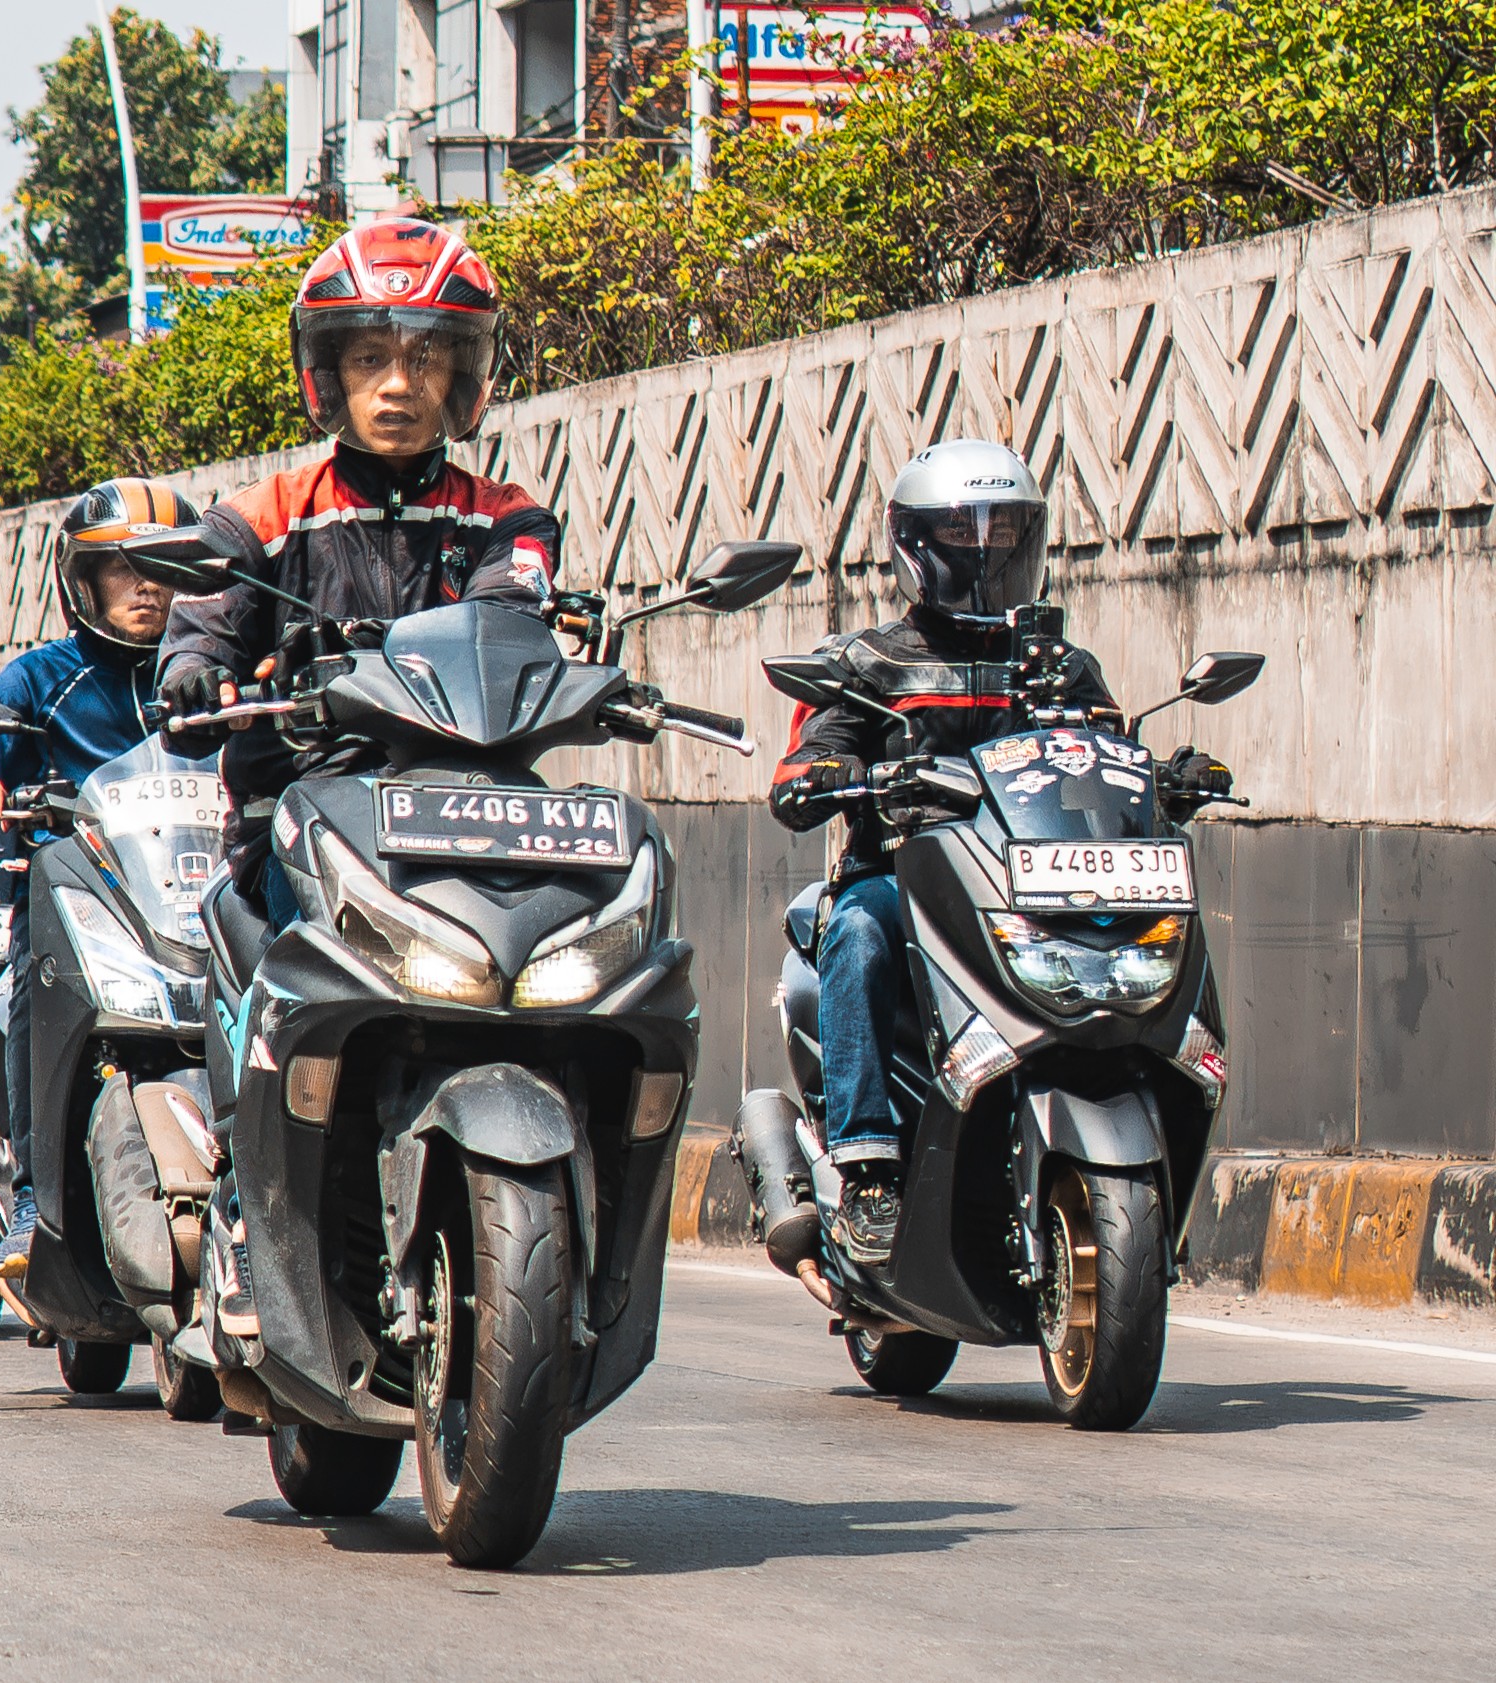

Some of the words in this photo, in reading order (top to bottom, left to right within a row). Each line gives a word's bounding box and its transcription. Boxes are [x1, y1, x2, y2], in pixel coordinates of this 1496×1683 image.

[107, 787, 121, 805] B
[136, 778, 199, 800] 4983
[392, 793, 414, 818] B
[440, 795, 529, 825] 4406
[542, 800, 615, 830] KVA
[398, 837, 452, 850] YAMAHA
[1019, 850, 1034, 873] B
[1049, 850, 1115, 873] 4488
[1129, 850, 1178, 873] SJD
[1026, 896, 1066, 907] YAMAHA
